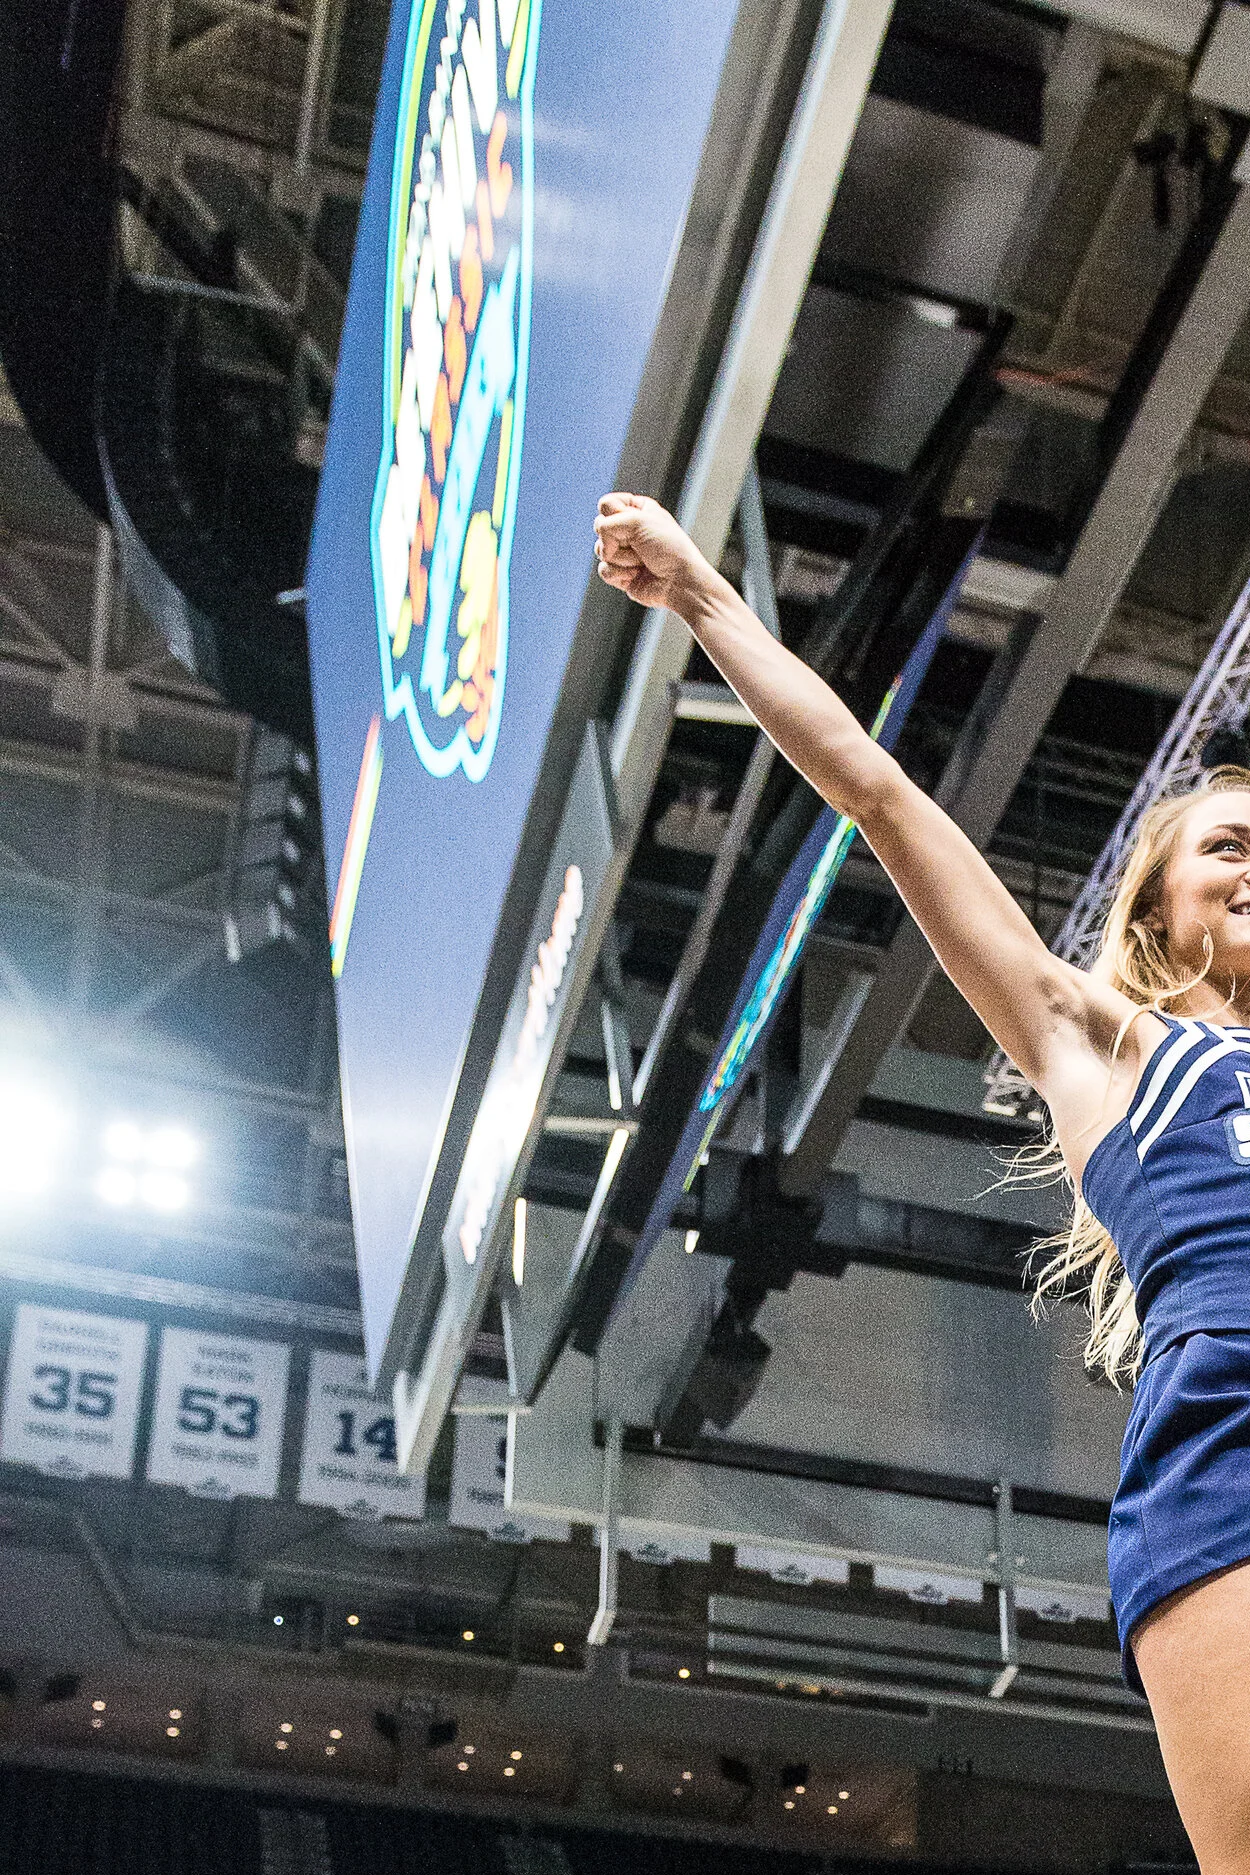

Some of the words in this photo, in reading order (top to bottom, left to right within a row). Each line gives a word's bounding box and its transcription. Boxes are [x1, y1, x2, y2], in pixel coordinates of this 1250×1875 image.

[29, 1362, 118, 1421] 35
[176, 1383, 261, 1439] 53
[333, 1410, 397, 1463] 14
